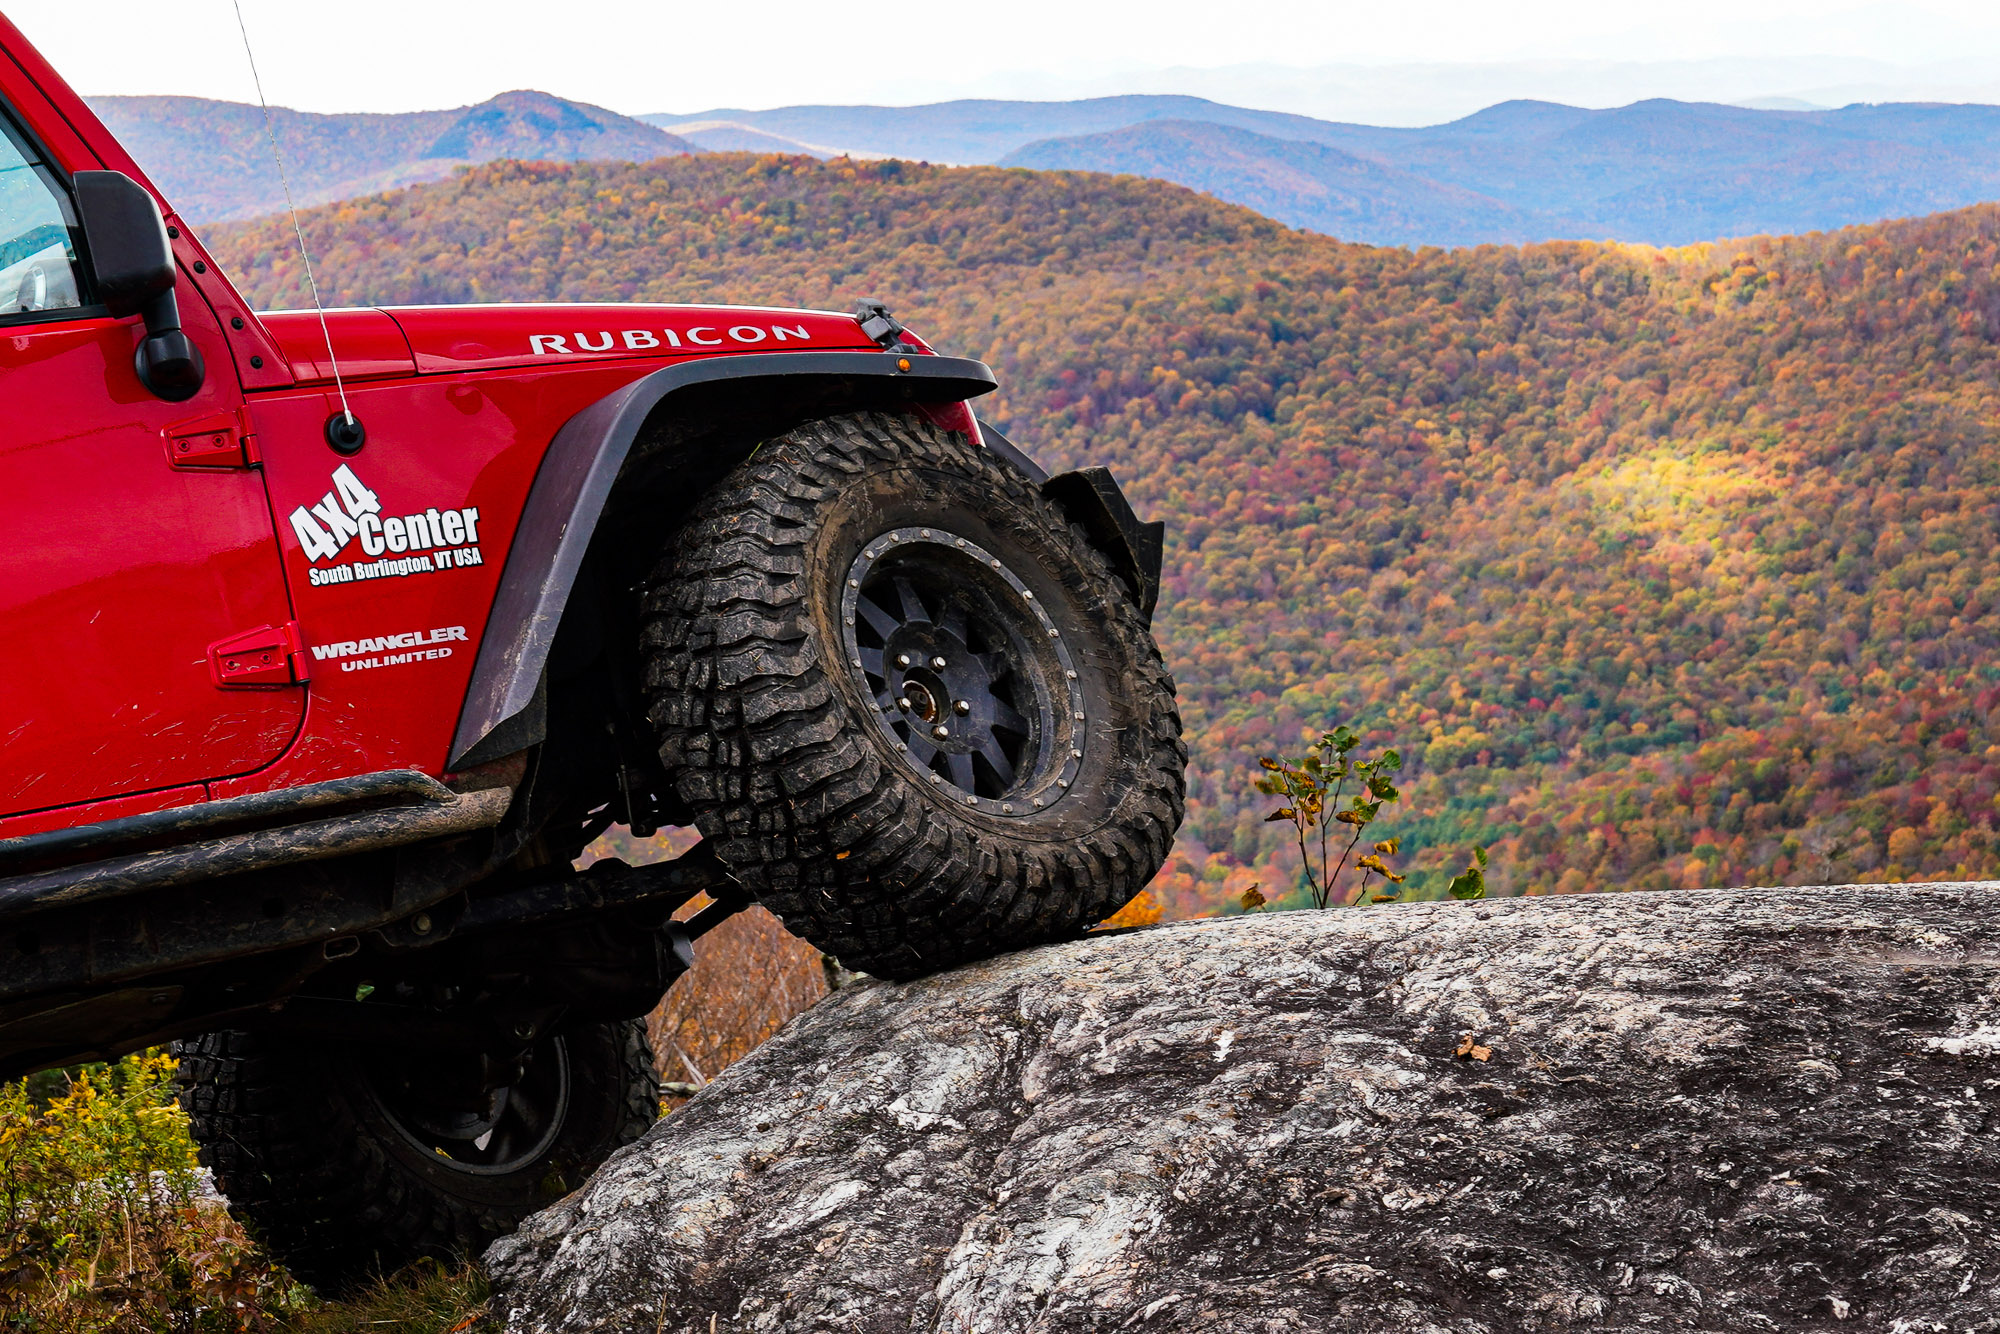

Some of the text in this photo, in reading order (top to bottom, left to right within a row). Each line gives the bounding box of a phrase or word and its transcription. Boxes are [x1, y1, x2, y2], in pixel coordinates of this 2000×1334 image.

[529, 325, 811, 355] RUBICON
[357, 507, 479, 556] Center
[309, 547, 483, 586] South Burlington, VT USA
[311, 625, 469, 661] WRANGLER
[341, 648, 453, 672] UNLIMITED
